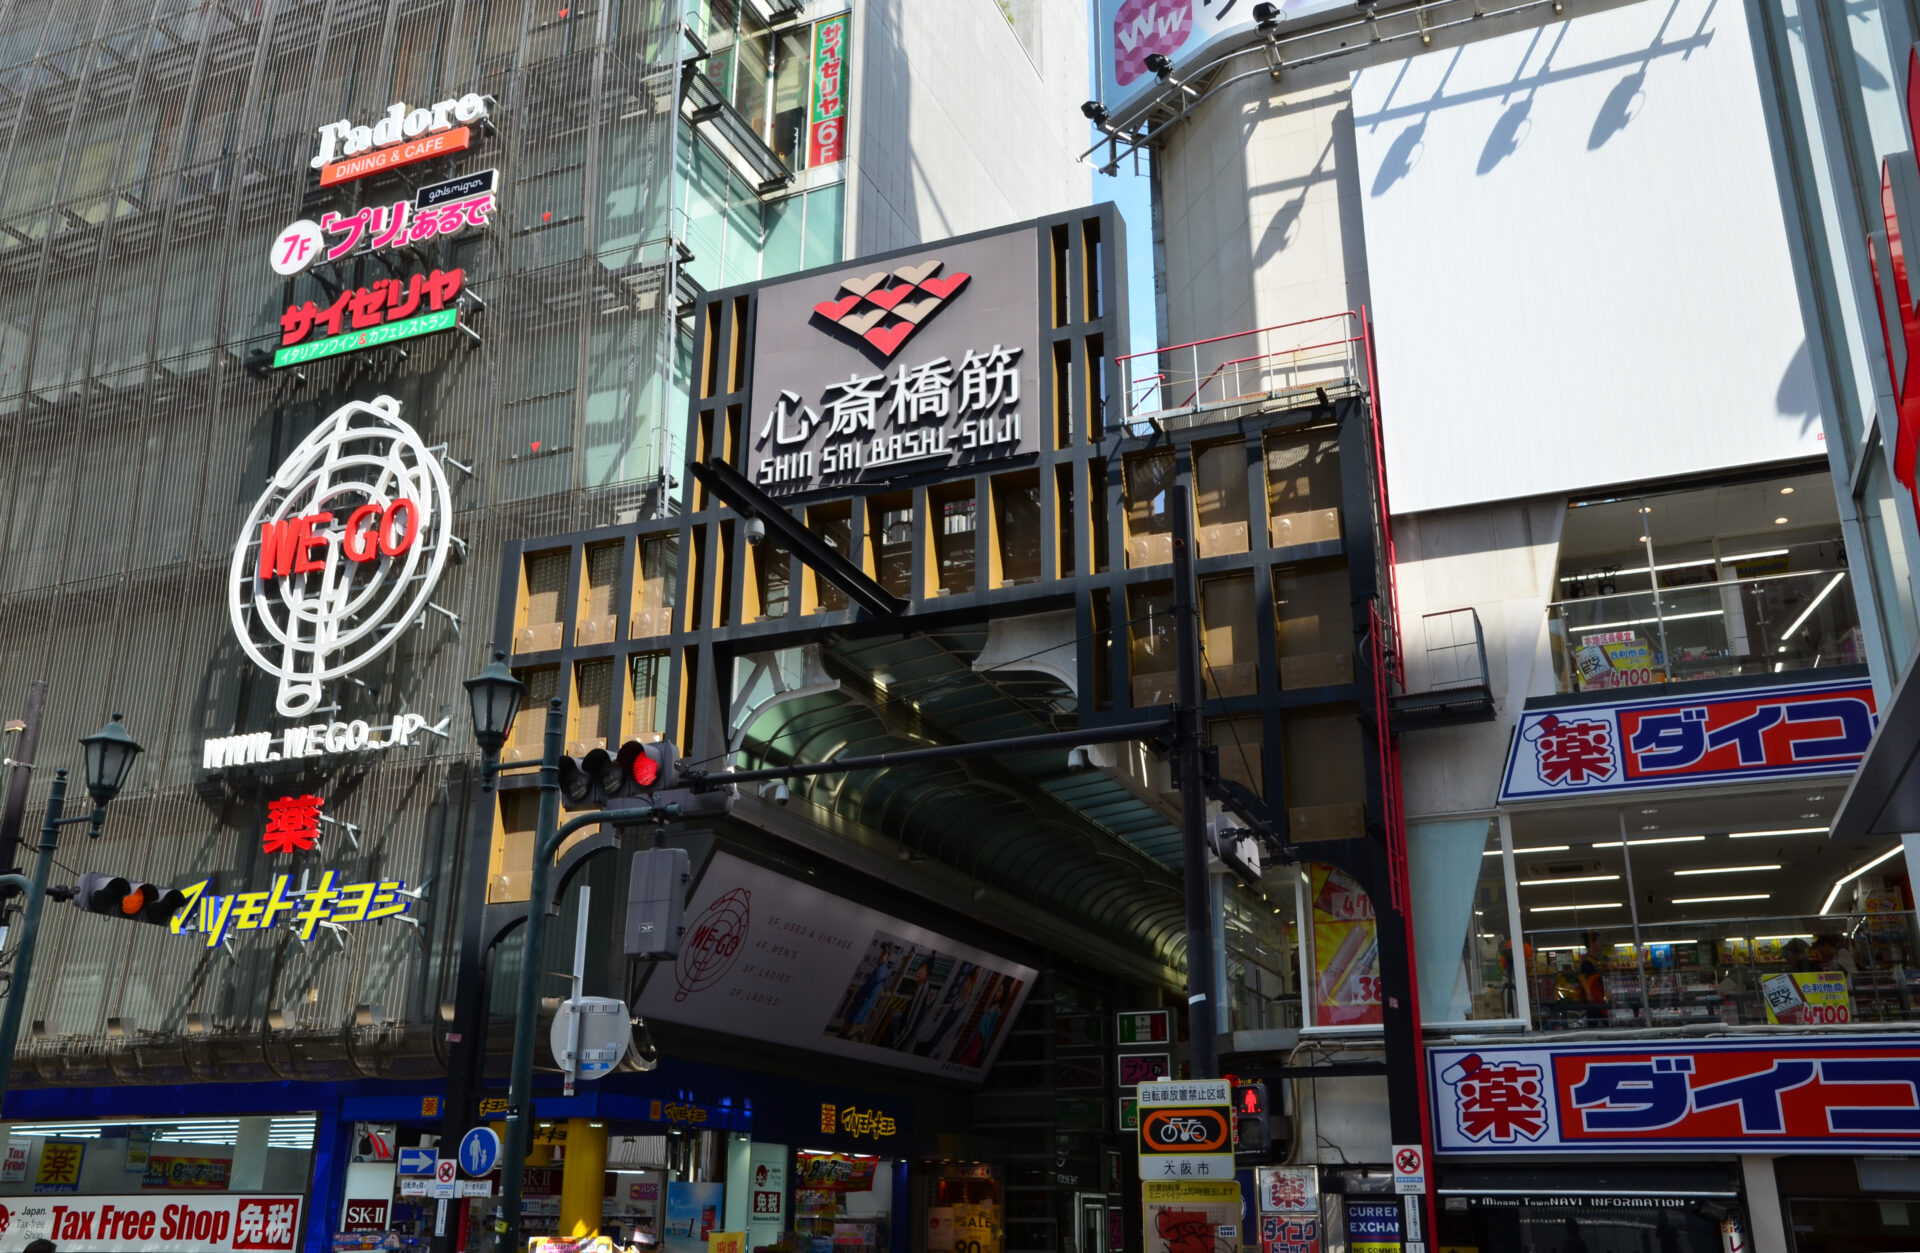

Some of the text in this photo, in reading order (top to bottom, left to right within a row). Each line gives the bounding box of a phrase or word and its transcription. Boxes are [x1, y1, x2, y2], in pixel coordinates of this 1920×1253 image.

[819, 22, 843, 116] サイゼリヤ
[311, 93, 486, 170] J'adore
[817, 120, 839, 165] 6F
[335, 135, 445, 179] DINING & CAFE
[280, 233, 312, 265] 7F
[280, 267, 465, 347] サイゼリヤ
[760, 344, 1023, 445] 心斎橋筋
[759, 452, 812, 484] SHIN
[823, 442, 861, 474] SAI
[258, 498, 419, 580] WE GO
[1610, 668, 1651, 688] 4700
[203, 713, 425, 769] WWW.WEGO.JP
[1541, 721, 1612, 783] 薬
[263, 794, 324, 854] 薬
[1802, 1004, 1849, 1024] 4700
[1142, 1088, 1226, 1102] 自転車放置禁止区域
[1459, 1065, 1545, 1139] 薬
[841, 1107, 897, 1140] マツモトキヨシ
[3, 1158, 25, 1172] Free
[8, 1147, 25, 1160] Tax
[1164, 1162, 1210, 1176] 大阪市
[756, 1192, 778, 1213] 免税
[960, 1217, 992, 1228] SALE
[1591, 1198, 1685, 1208] INFORMATION
[16, 1218, 46, 1230] Tax-free
[51, 1204, 230, 1244] Tax Free Shop
[237, 1203, 294, 1244] 免税
[1264, 1218, 1318, 1241] ダイコク
